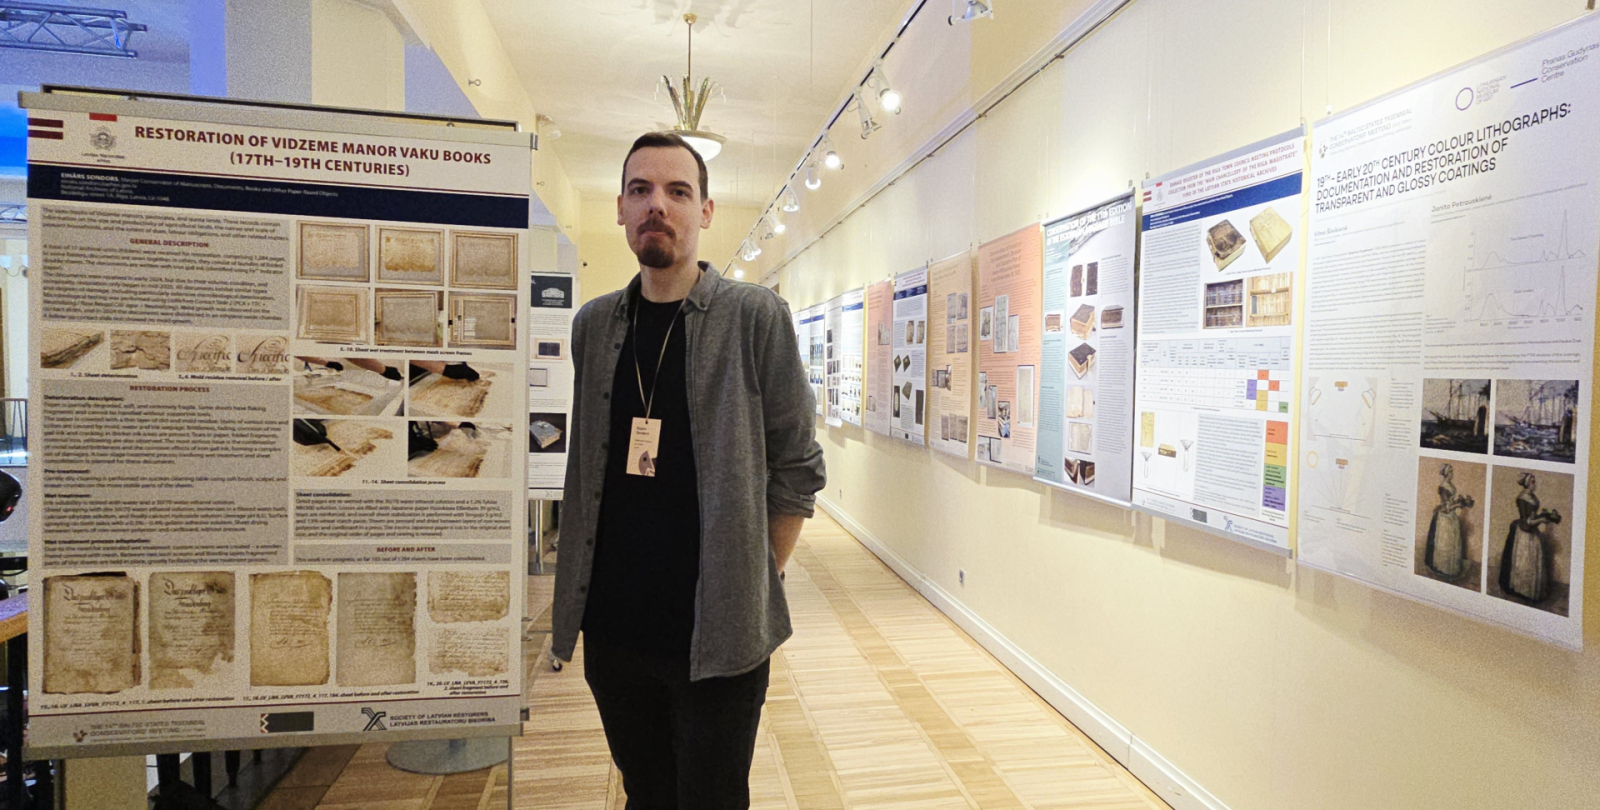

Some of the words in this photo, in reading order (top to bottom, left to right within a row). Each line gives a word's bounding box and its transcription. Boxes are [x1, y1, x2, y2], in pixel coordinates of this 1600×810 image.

[1541, 55, 1588, 75] Conservation
[1542, 55, 1566, 67] Pranas
[1567, 43, 1599, 57] Gudynas
[1541, 70, 1564, 83] Centre
[135, 126, 244, 146] RESTORATION
[248, 136, 268, 147] OF
[272, 138, 339, 152] VIDZEME
[342, 141, 397, 157] MANOR
[400, 147, 439, 160] VAKU
[444, 151, 491, 164] BOOKS
[1337, 165, 1362, 183] EARLY
[1382, 146, 1426, 170] CENTURY
[1428, 131, 1474, 156] COLOUR
[1476, 103, 1571, 142] LITHOGRAPHS:
[324, 159, 410, 178] CENTURIES)
[1317, 171, 1390, 201] DOCUMENTATION
[1392, 165, 1412, 181] AND
[1414, 143, 1488, 175] RESTORATION
[1492, 137, 1508, 154] OF
[1315, 189, 1374, 214] TRANSPARENT
[1376, 184, 1395, 200] AND
[1398, 173, 1437, 194] GLOSSY
[1438, 157, 1496, 183] COATINGS
[1109, 202, 1132, 216] EDITION
[130, 238, 160, 246] GENERAL
[163, 240, 209, 248] DESCRIPTION
